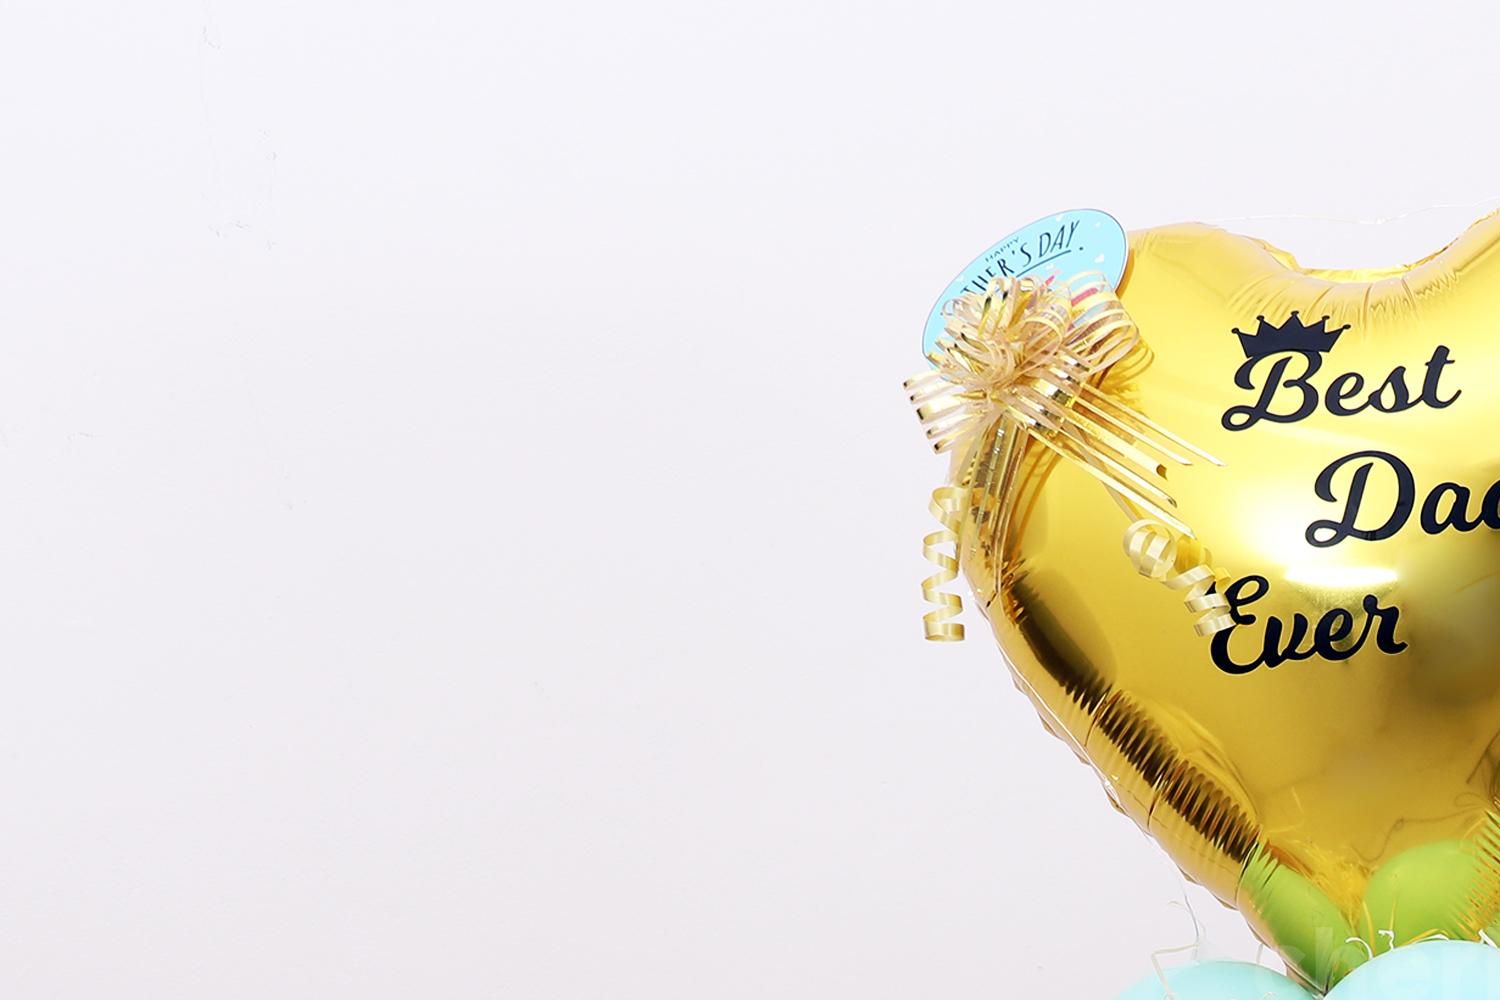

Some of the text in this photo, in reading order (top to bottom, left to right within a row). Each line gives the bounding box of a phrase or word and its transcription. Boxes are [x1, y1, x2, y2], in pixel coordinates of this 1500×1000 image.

[960, 242, 1032, 295] THER'S
[1220, 345, 1463, 432] Best
[1205, 574, 1409, 674] Ever
